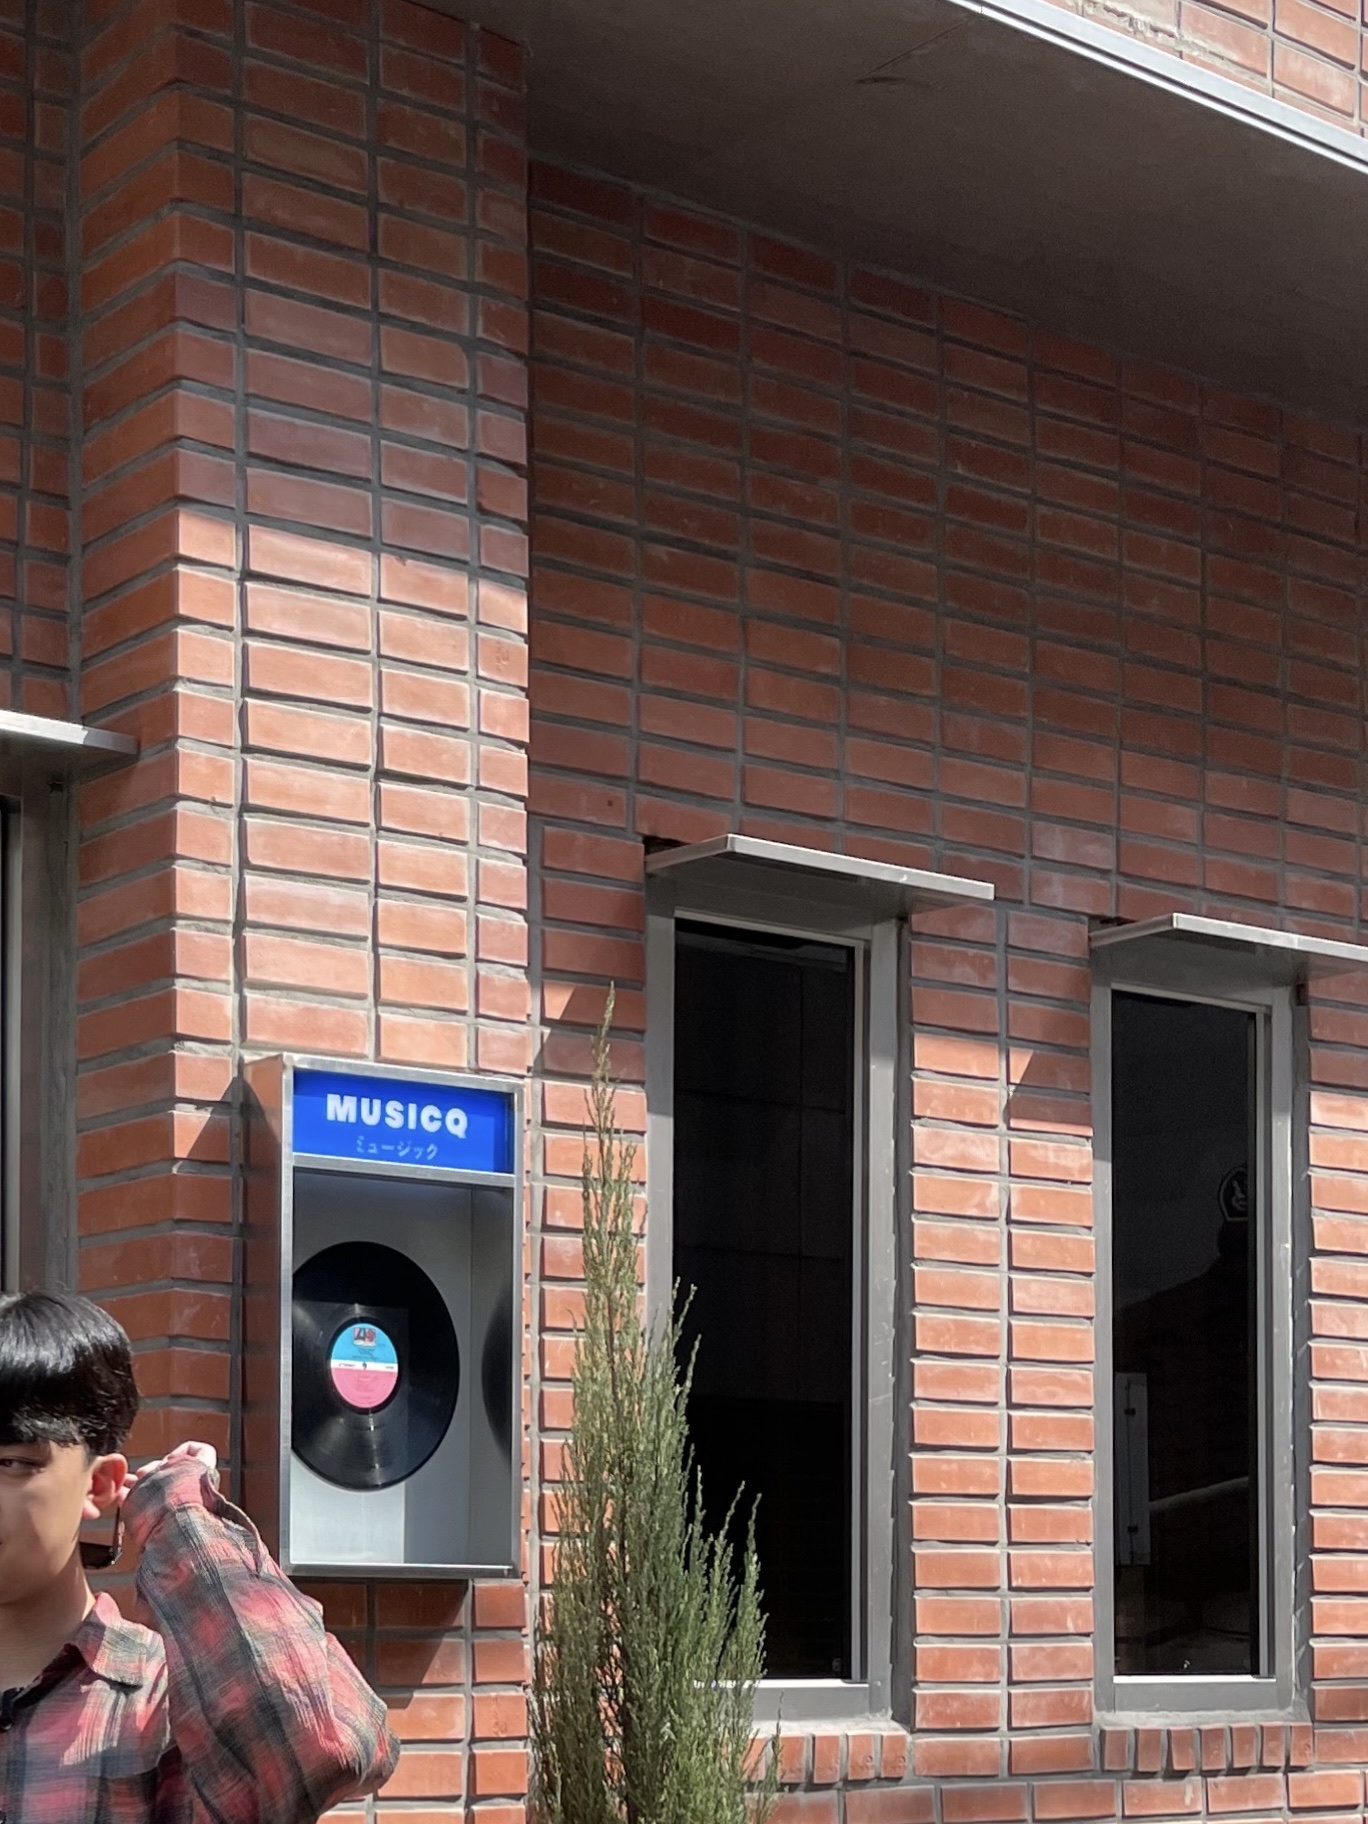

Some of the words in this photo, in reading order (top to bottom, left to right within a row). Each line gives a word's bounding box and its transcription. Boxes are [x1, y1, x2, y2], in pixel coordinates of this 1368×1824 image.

[326, 1093, 469, 1139] MUSICQ
[355, 1135, 439, 1161] ミュージック
